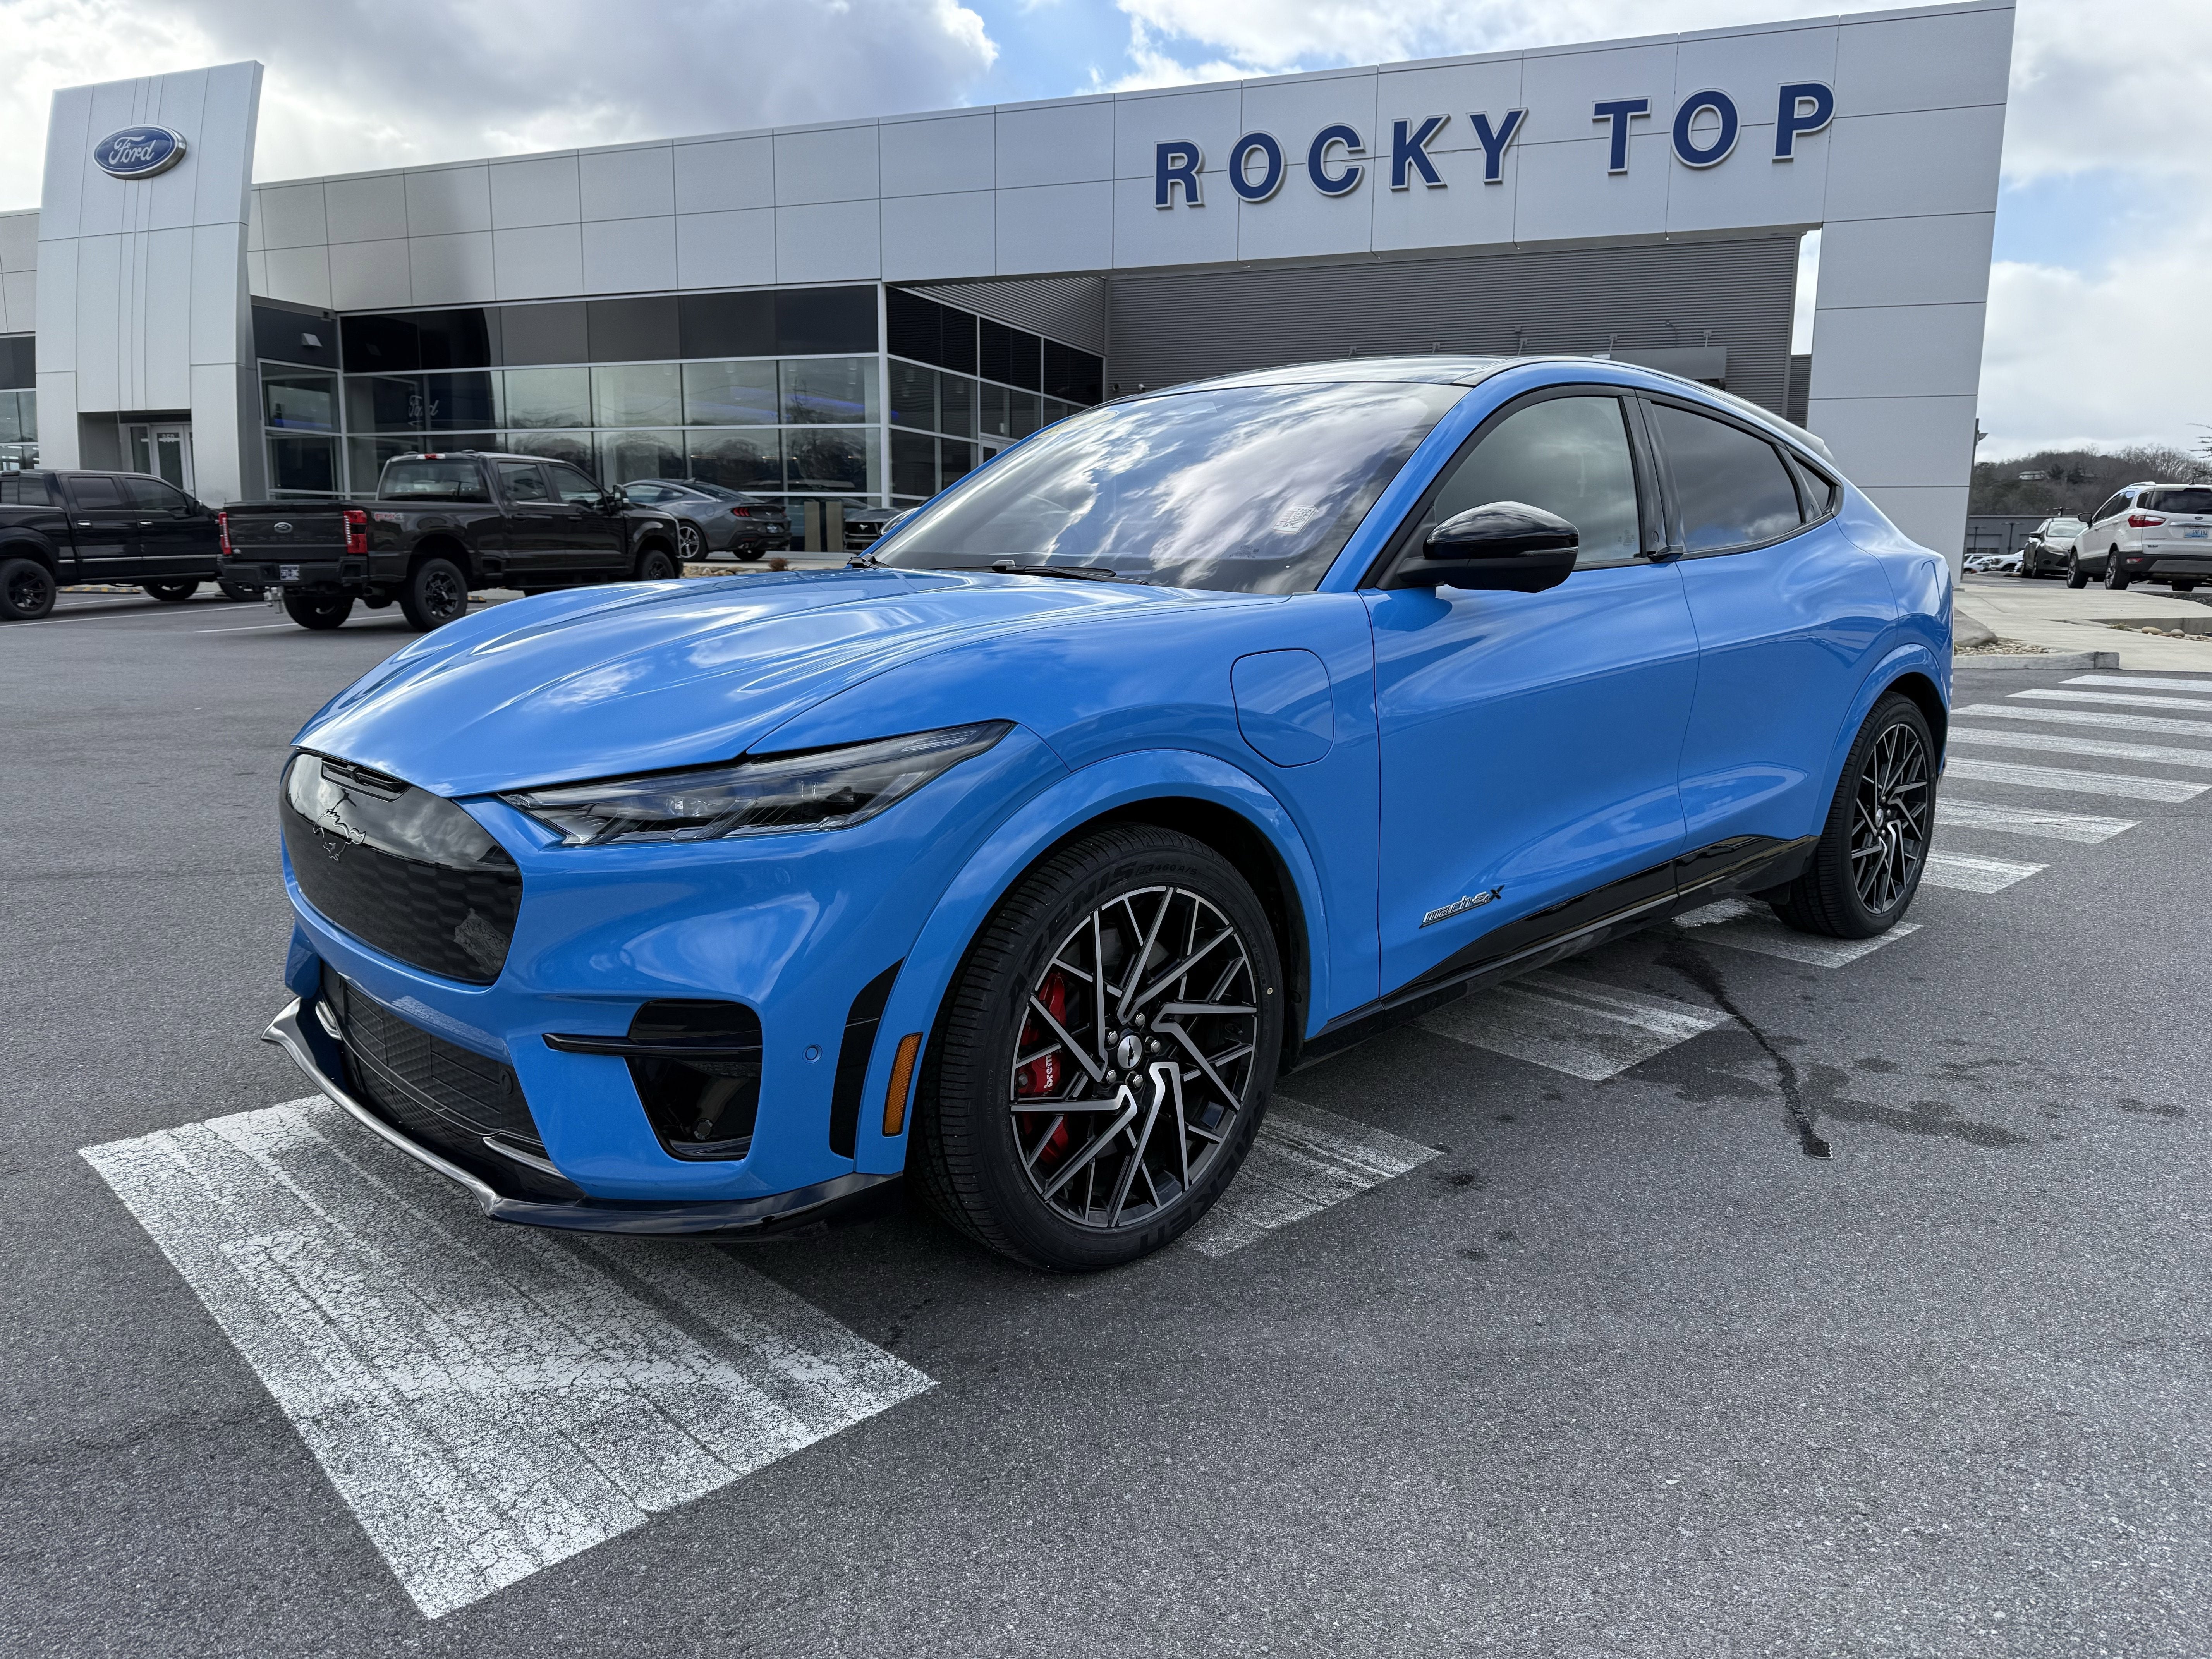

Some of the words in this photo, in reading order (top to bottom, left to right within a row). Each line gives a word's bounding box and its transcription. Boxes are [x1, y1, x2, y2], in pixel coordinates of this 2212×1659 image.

[109, 136, 156, 165] Ford
[1154, 107, 1528, 208] ROCKY
[1592, 80, 1836, 173] TOP
[408, 395, 439, 417] Fod
[1044, 1053, 1053, 1089] brem
